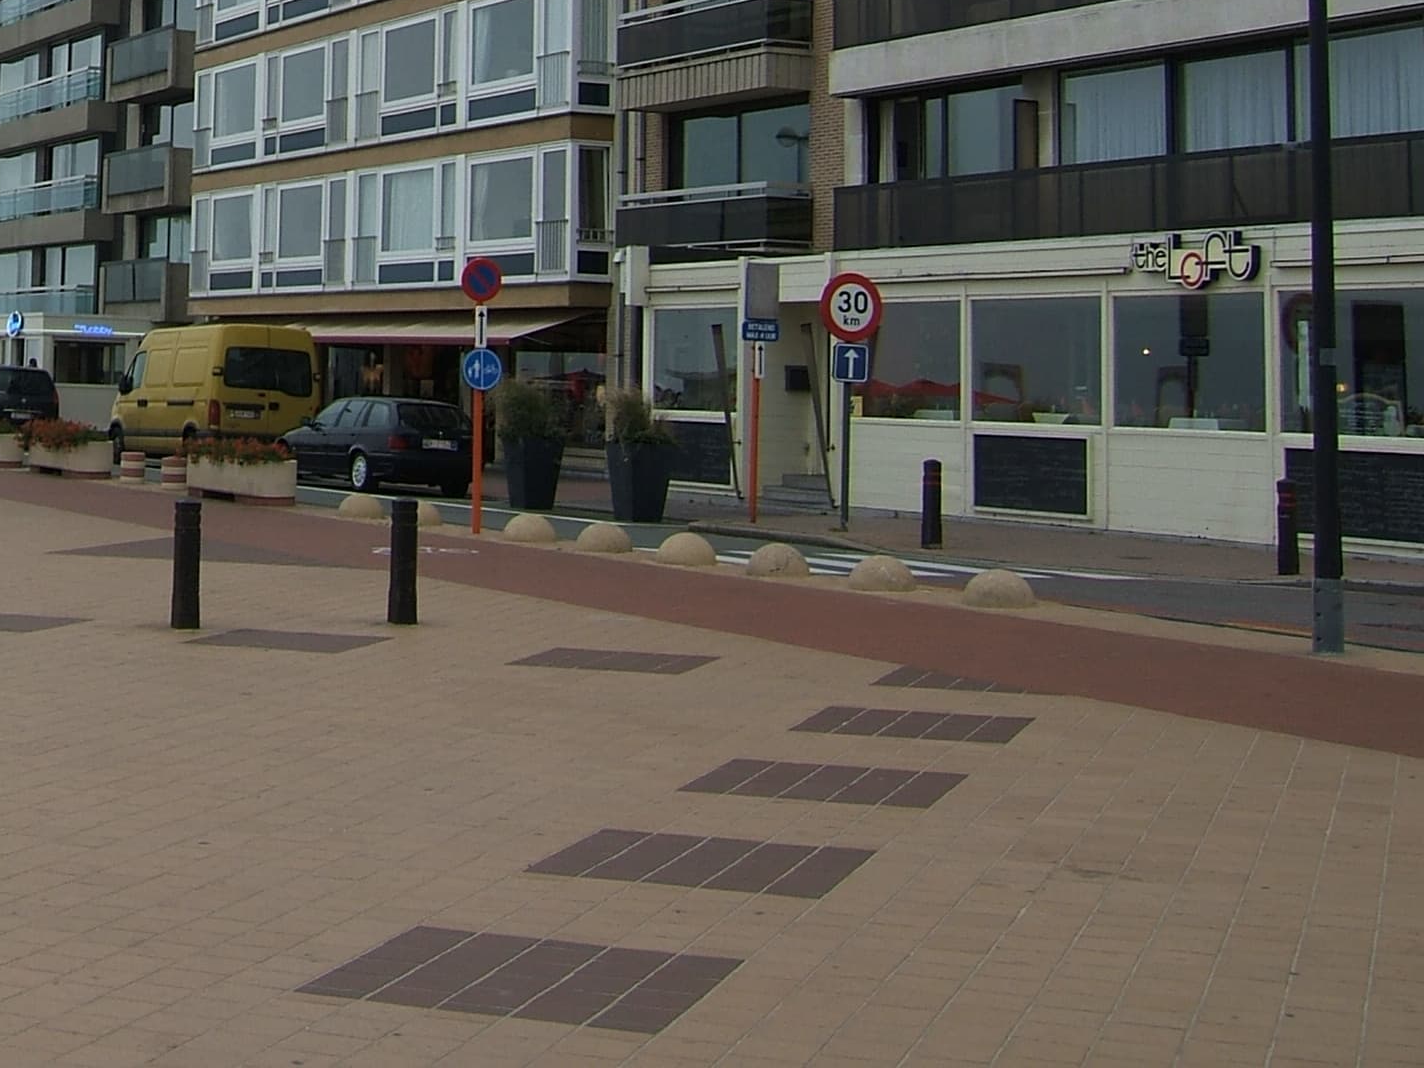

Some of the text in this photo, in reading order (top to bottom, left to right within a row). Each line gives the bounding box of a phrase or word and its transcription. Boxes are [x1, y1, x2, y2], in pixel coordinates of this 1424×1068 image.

[1133, 243, 1168, 271] the
[837, 290, 868, 314] 30
[843, 314, 860, 326] km
